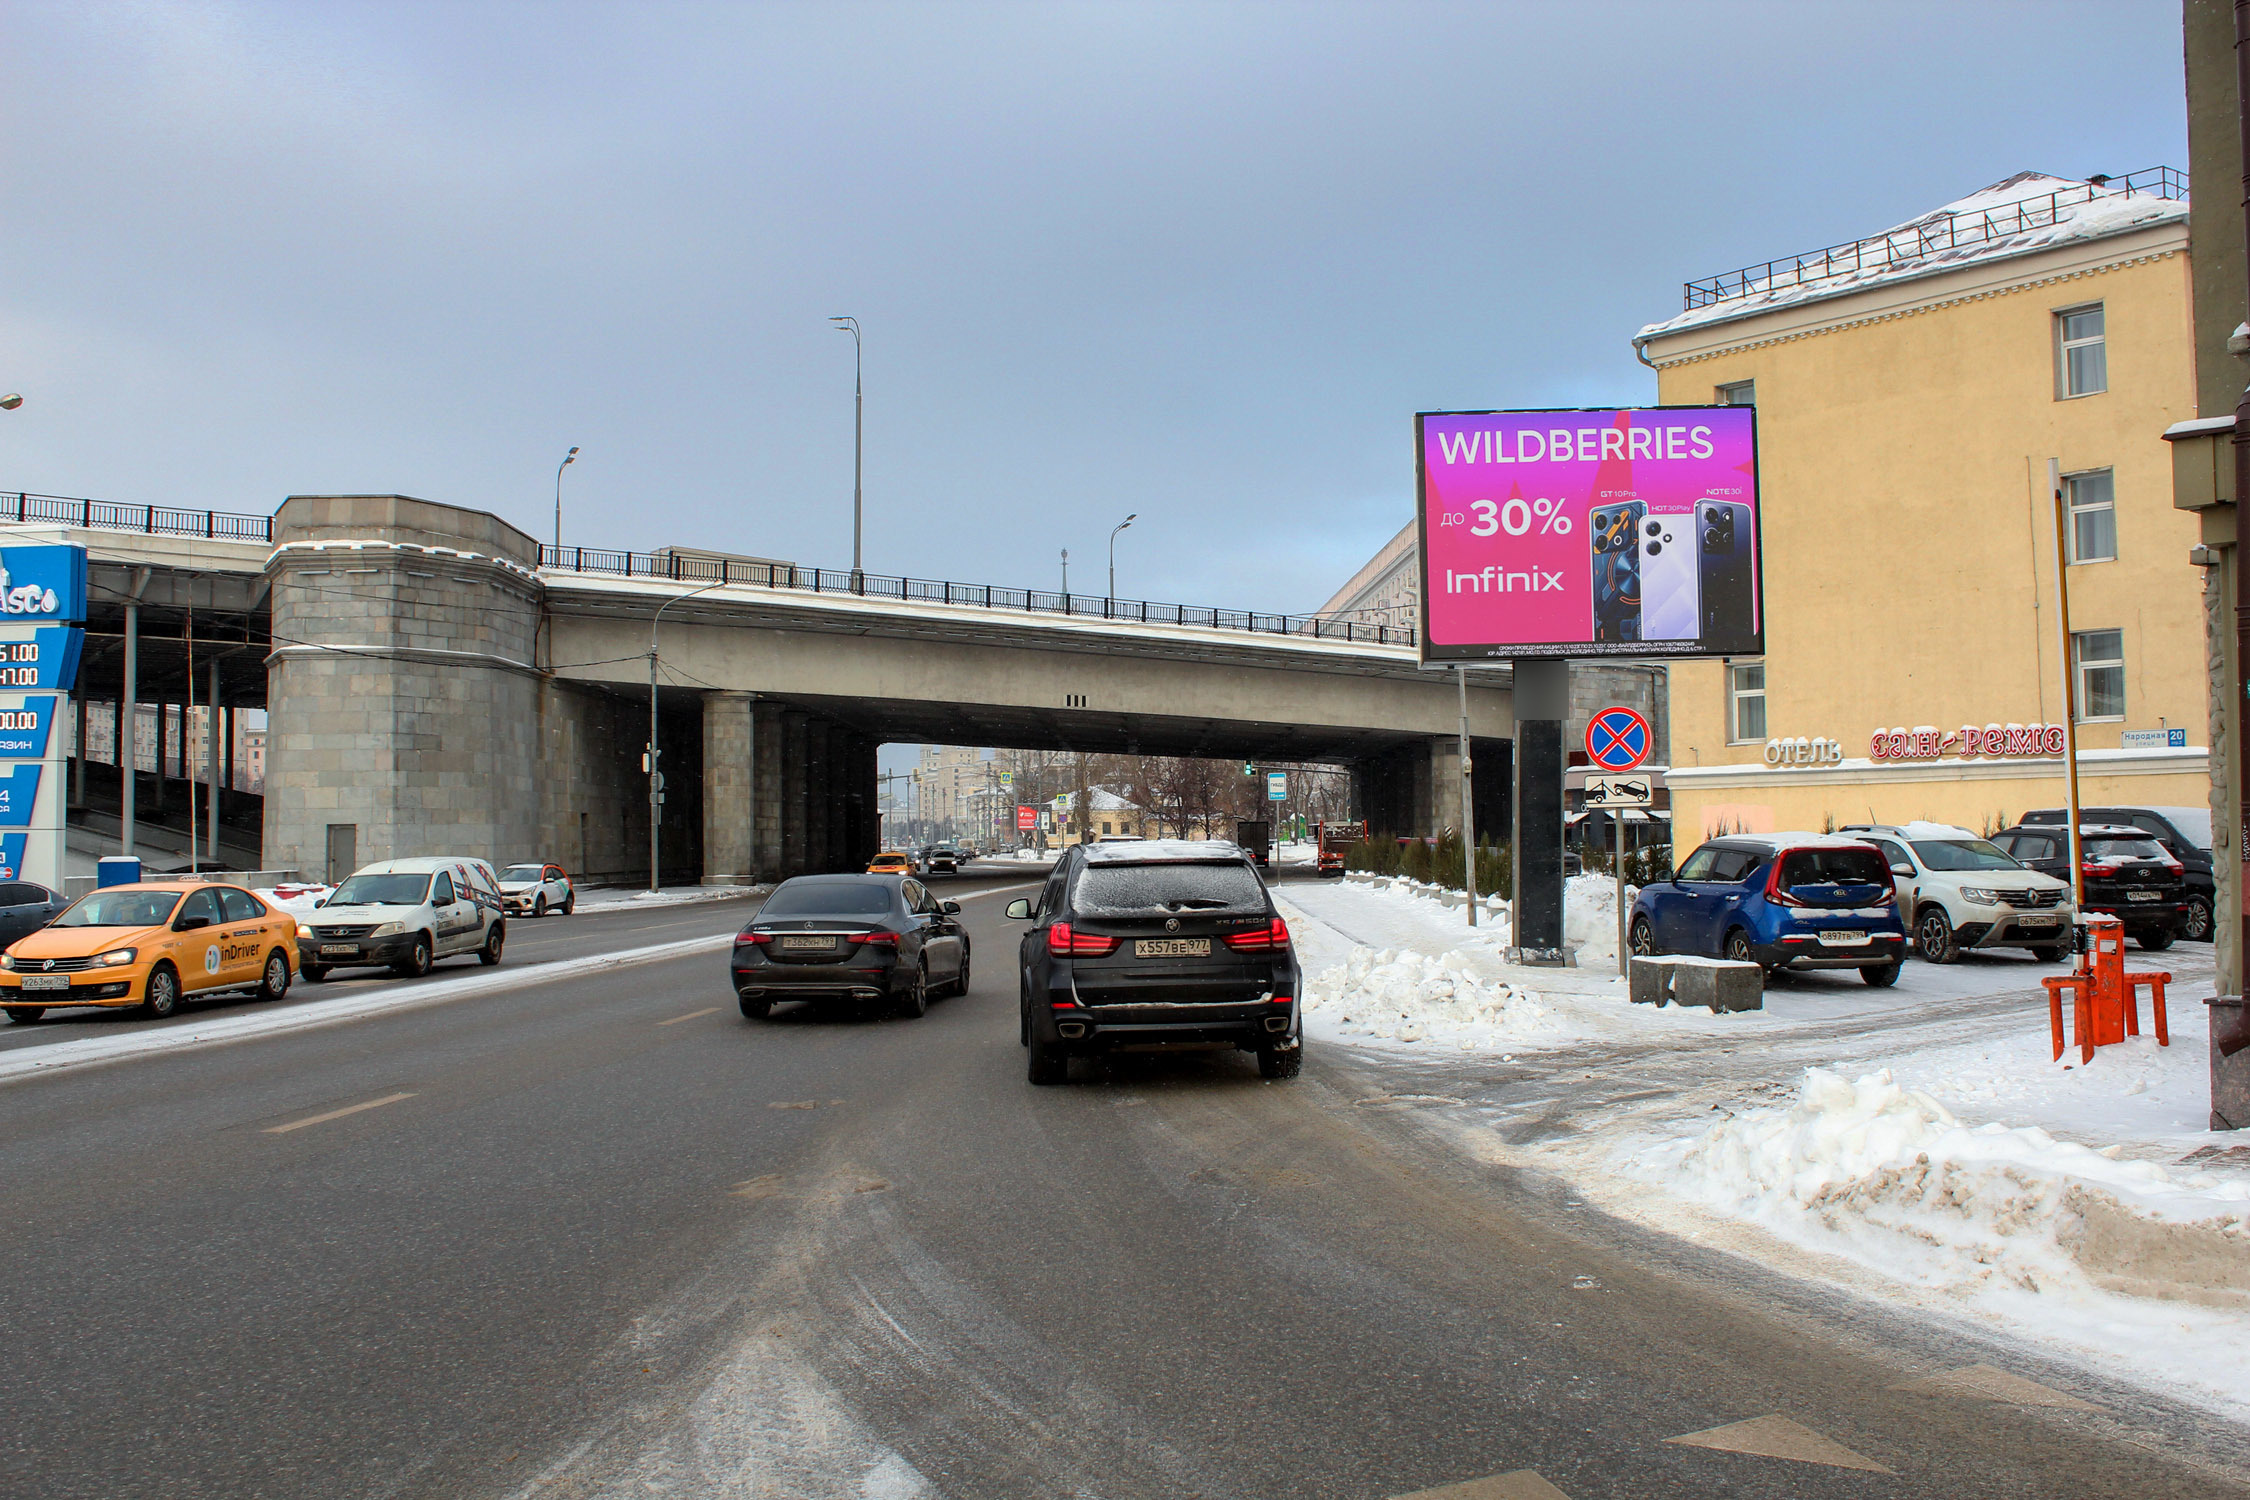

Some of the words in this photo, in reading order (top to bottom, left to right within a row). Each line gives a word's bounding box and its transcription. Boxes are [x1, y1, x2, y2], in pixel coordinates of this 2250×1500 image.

[1438, 426, 1714, 465] WILDBERRIES
[1441, 512, 1465, 527] ДО
[1470, 498, 1572, 536] 30%
[1446, 565, 1564, 593] Infinix
[2125, 733, 2166, 741] Народная
[2170, 731, 2183, 740] 20
[1764, 741, 1842, 764] ОТЕЛЬ
[220, 943, 260, 961] inDriver
[1140, 941, 1186, 953] Х557ВЕ
[1189, 940, 1207, 949] 977
